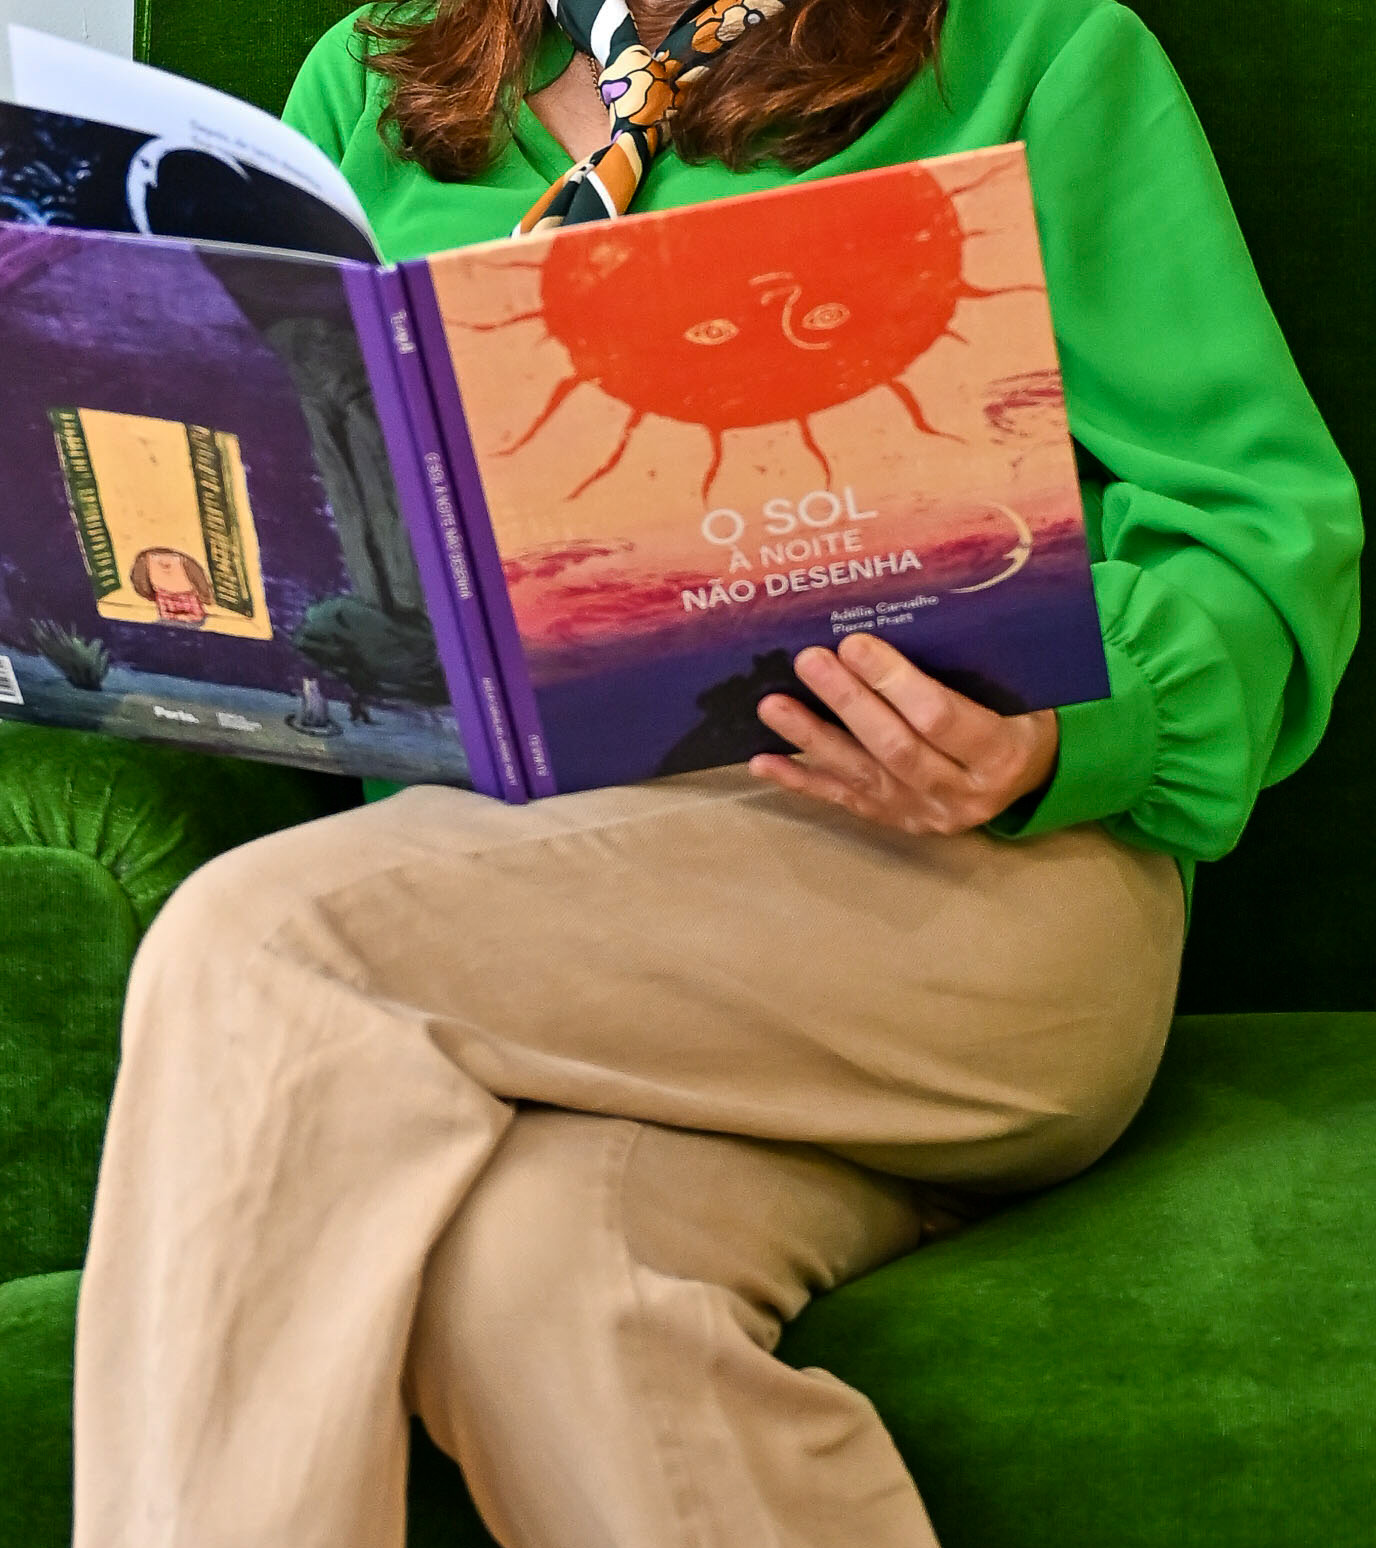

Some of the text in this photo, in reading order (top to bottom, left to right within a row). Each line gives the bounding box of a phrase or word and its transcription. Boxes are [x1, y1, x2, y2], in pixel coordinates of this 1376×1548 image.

[701, 487, 878, 545] O SOL
[760, 528, 865, 568] NOITE
[682, 549, 923, 612] NÃO DESENHA
